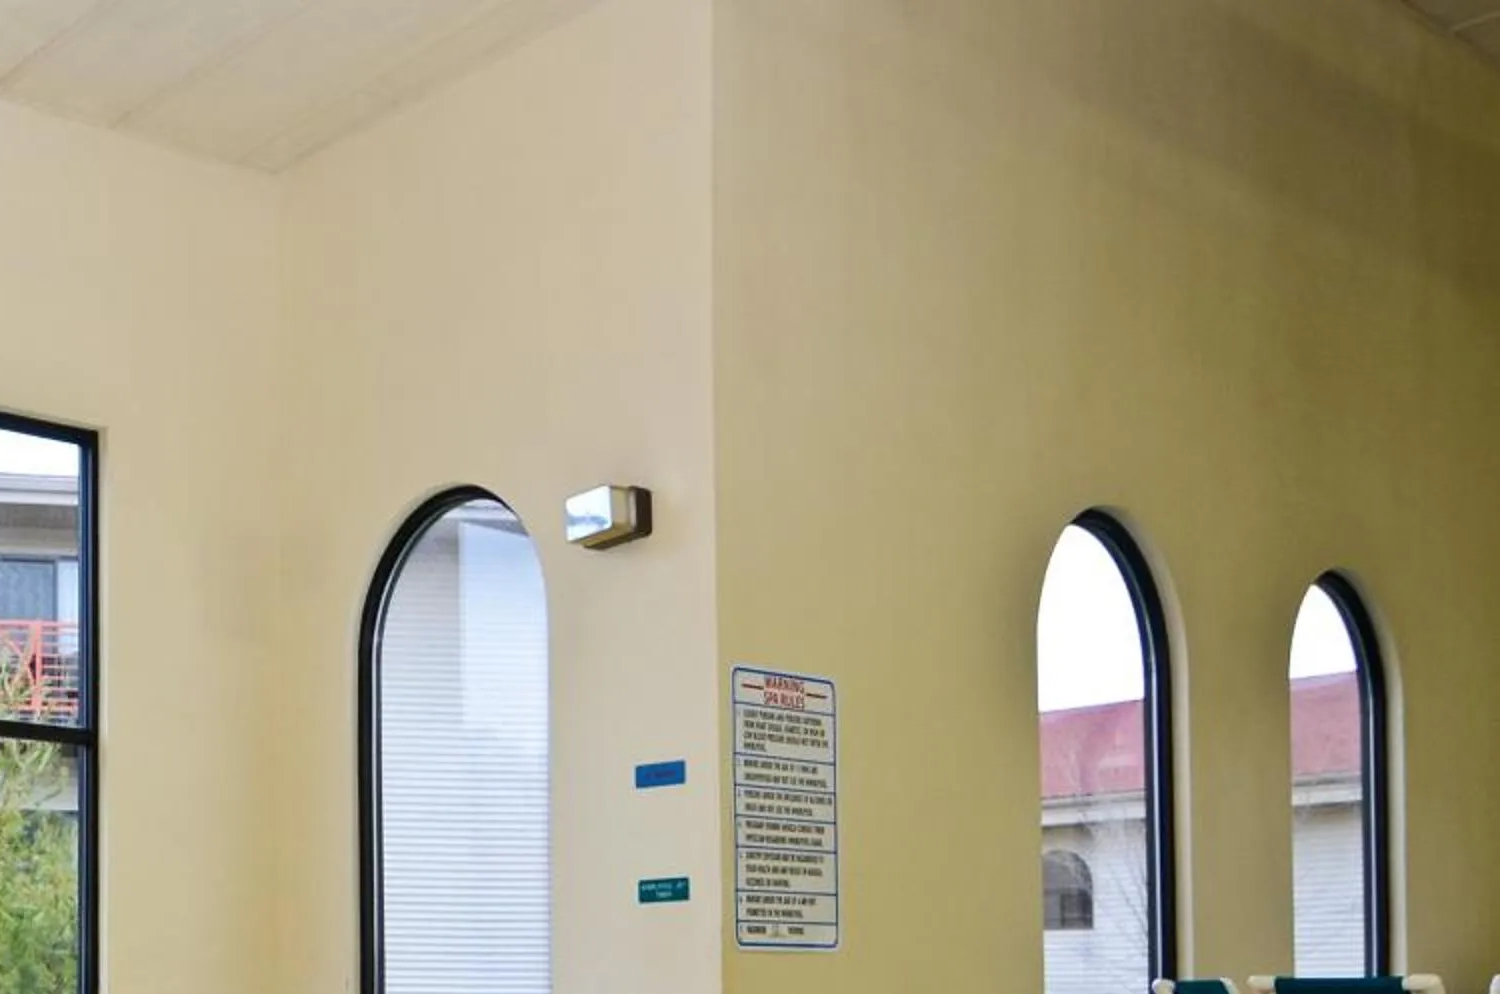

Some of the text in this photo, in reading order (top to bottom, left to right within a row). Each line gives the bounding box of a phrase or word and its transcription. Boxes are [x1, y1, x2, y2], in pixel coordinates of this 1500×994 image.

[764, 677, 804, 694] WARNING
[763, 691, 805, 711] SPA RULES
